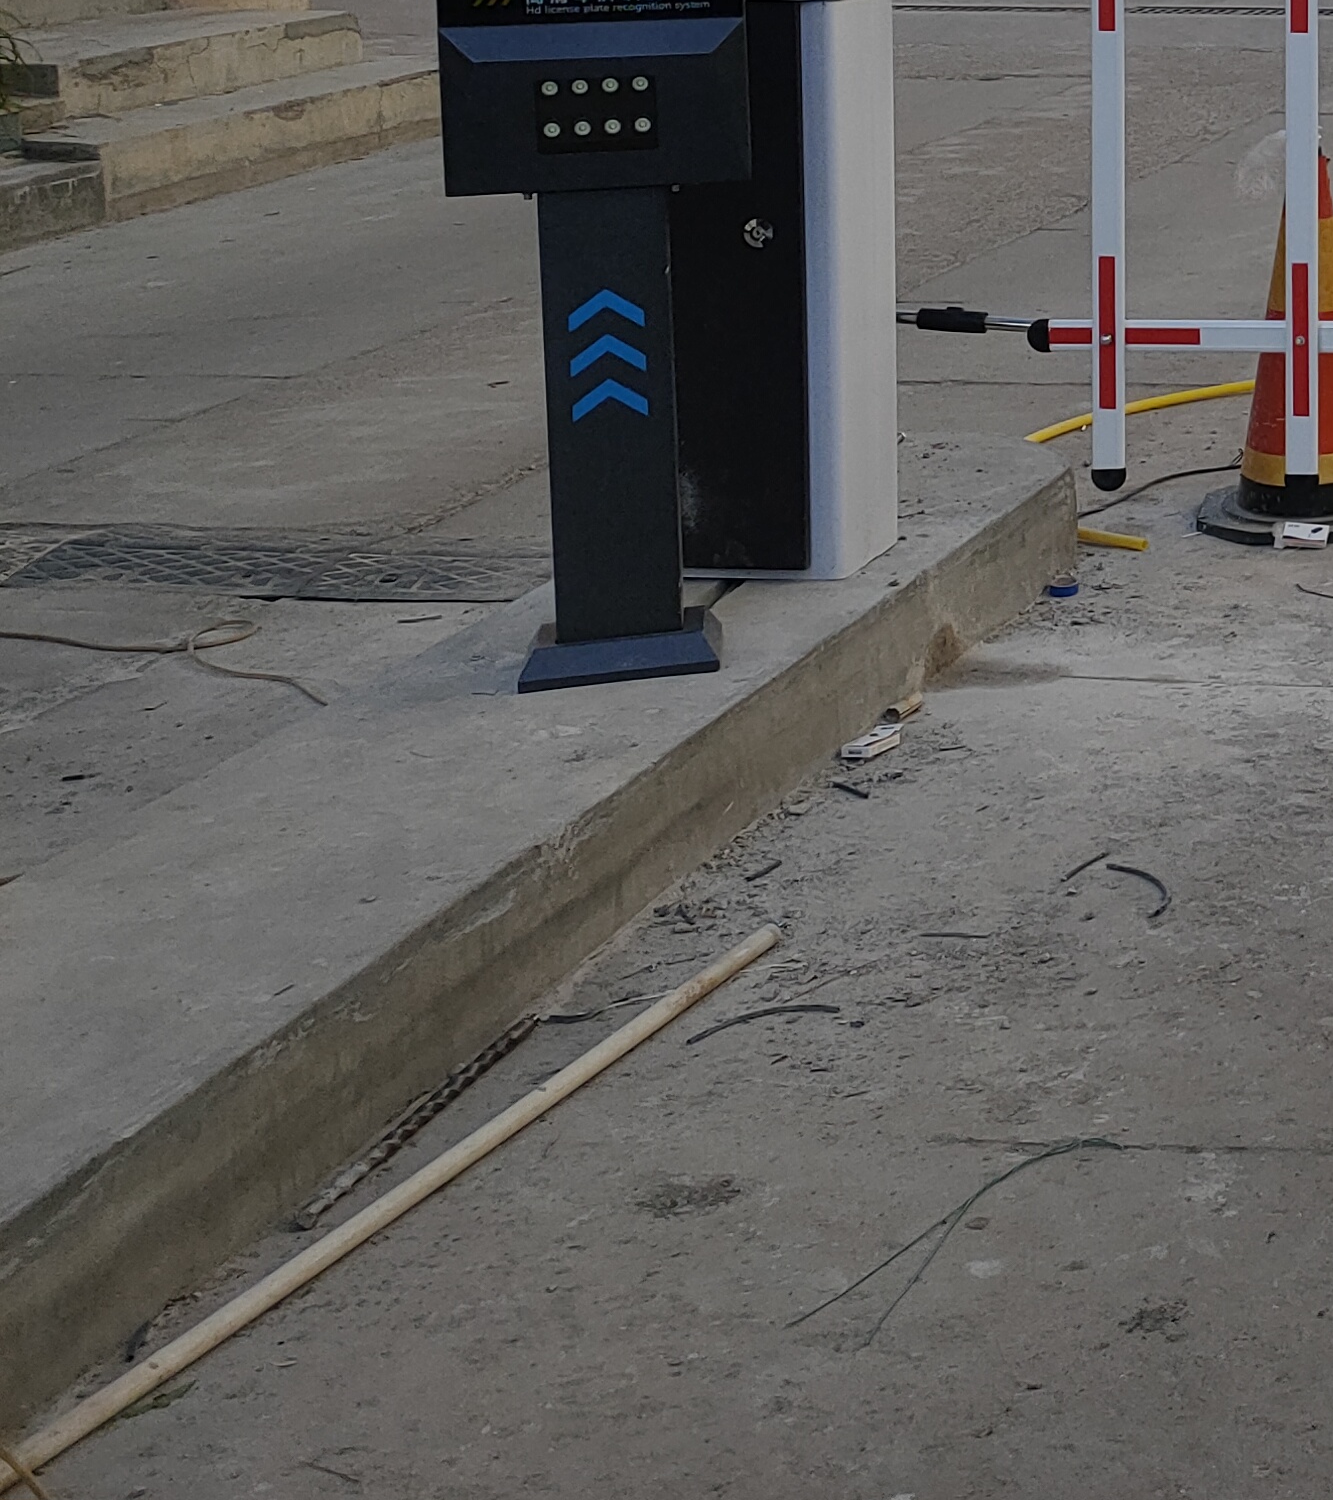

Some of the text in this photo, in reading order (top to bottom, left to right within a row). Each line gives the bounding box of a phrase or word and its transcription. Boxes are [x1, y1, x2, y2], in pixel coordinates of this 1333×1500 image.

[526, 1, 711, 15] Hd license plate recognition system
